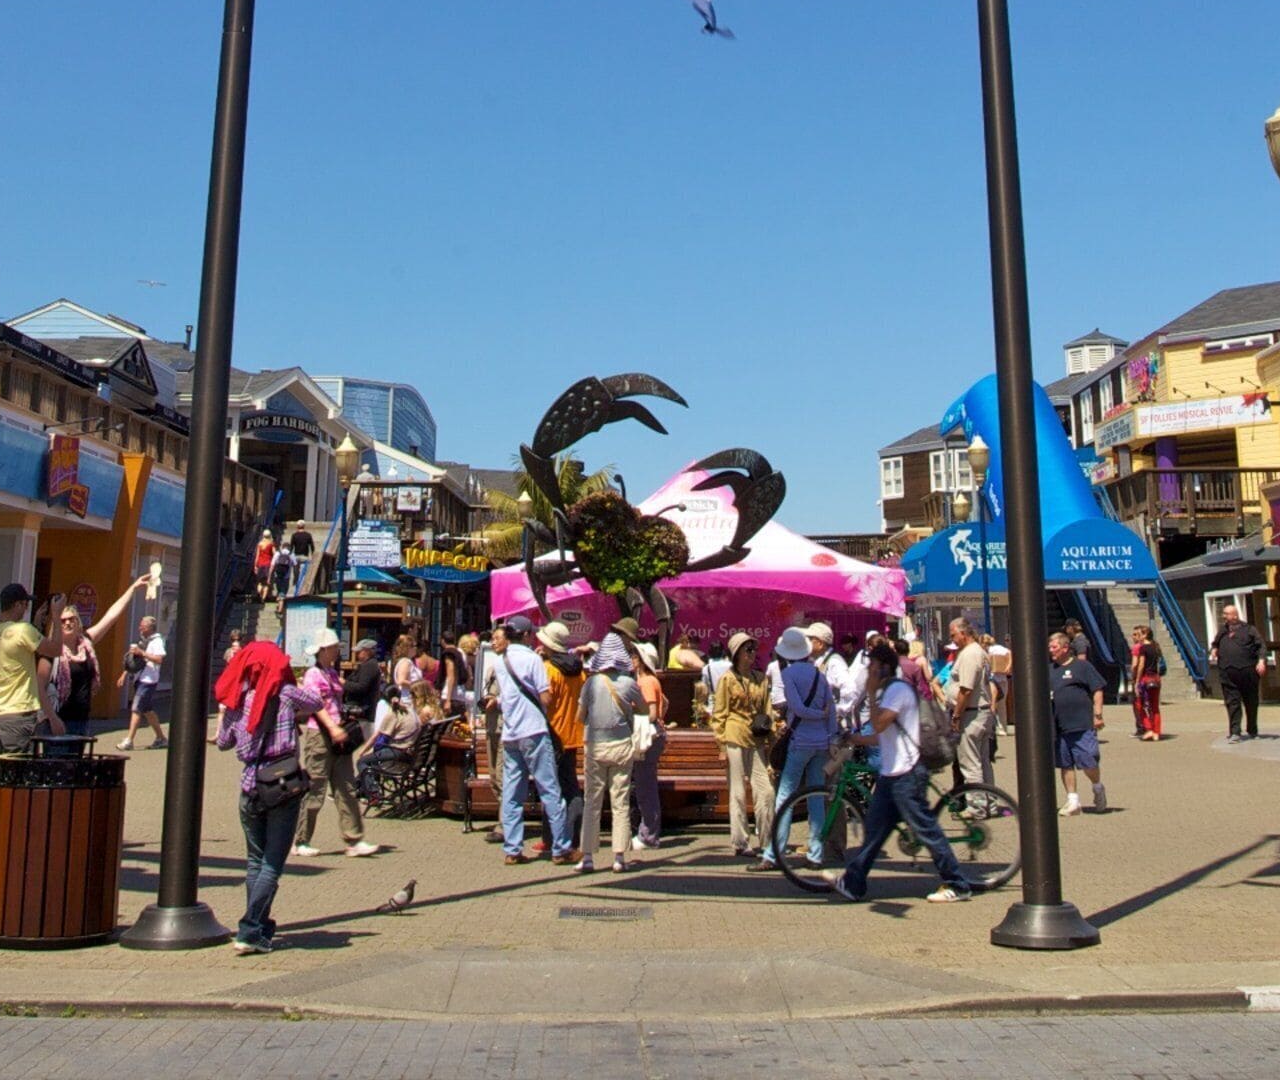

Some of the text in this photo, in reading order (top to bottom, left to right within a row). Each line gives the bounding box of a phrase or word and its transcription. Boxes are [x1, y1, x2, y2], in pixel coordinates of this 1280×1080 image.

[245, 415, 320, 435] FOG HARBOR
[404, 546, 489, 572] WIPEOUT
[1060, 545, 1133, 558] AQUARIUM
[1061, 559, 1133, 571] ENTRANCE
[680, 623, 713, 639] Your
[719, 623, 771, 638] Senses
